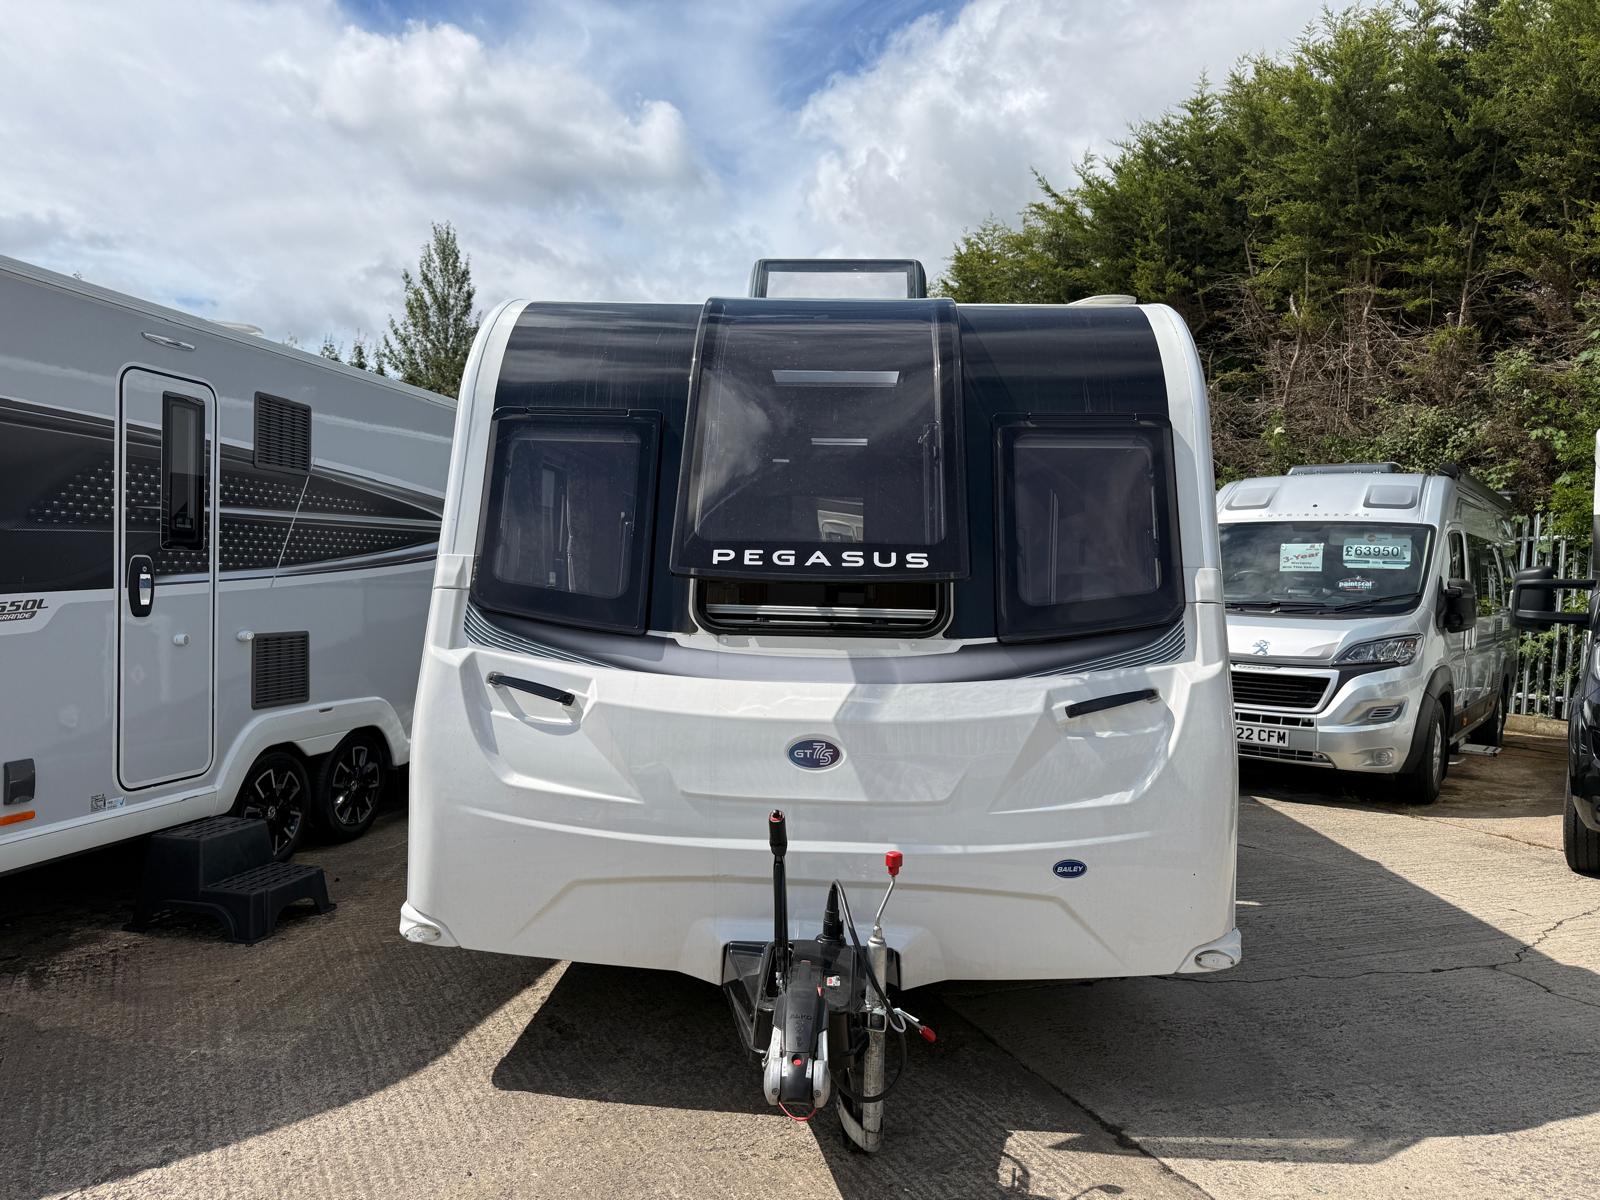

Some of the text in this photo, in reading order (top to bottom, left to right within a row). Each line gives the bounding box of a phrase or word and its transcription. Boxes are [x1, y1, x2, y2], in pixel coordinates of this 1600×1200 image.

[1345, 546, 1400, 557] £63950
[712, 549, 929, 569] PEGASUS
[1257, 729, 1286, 744] CFM
[1056, 865, 1084, 873] BAILEY
